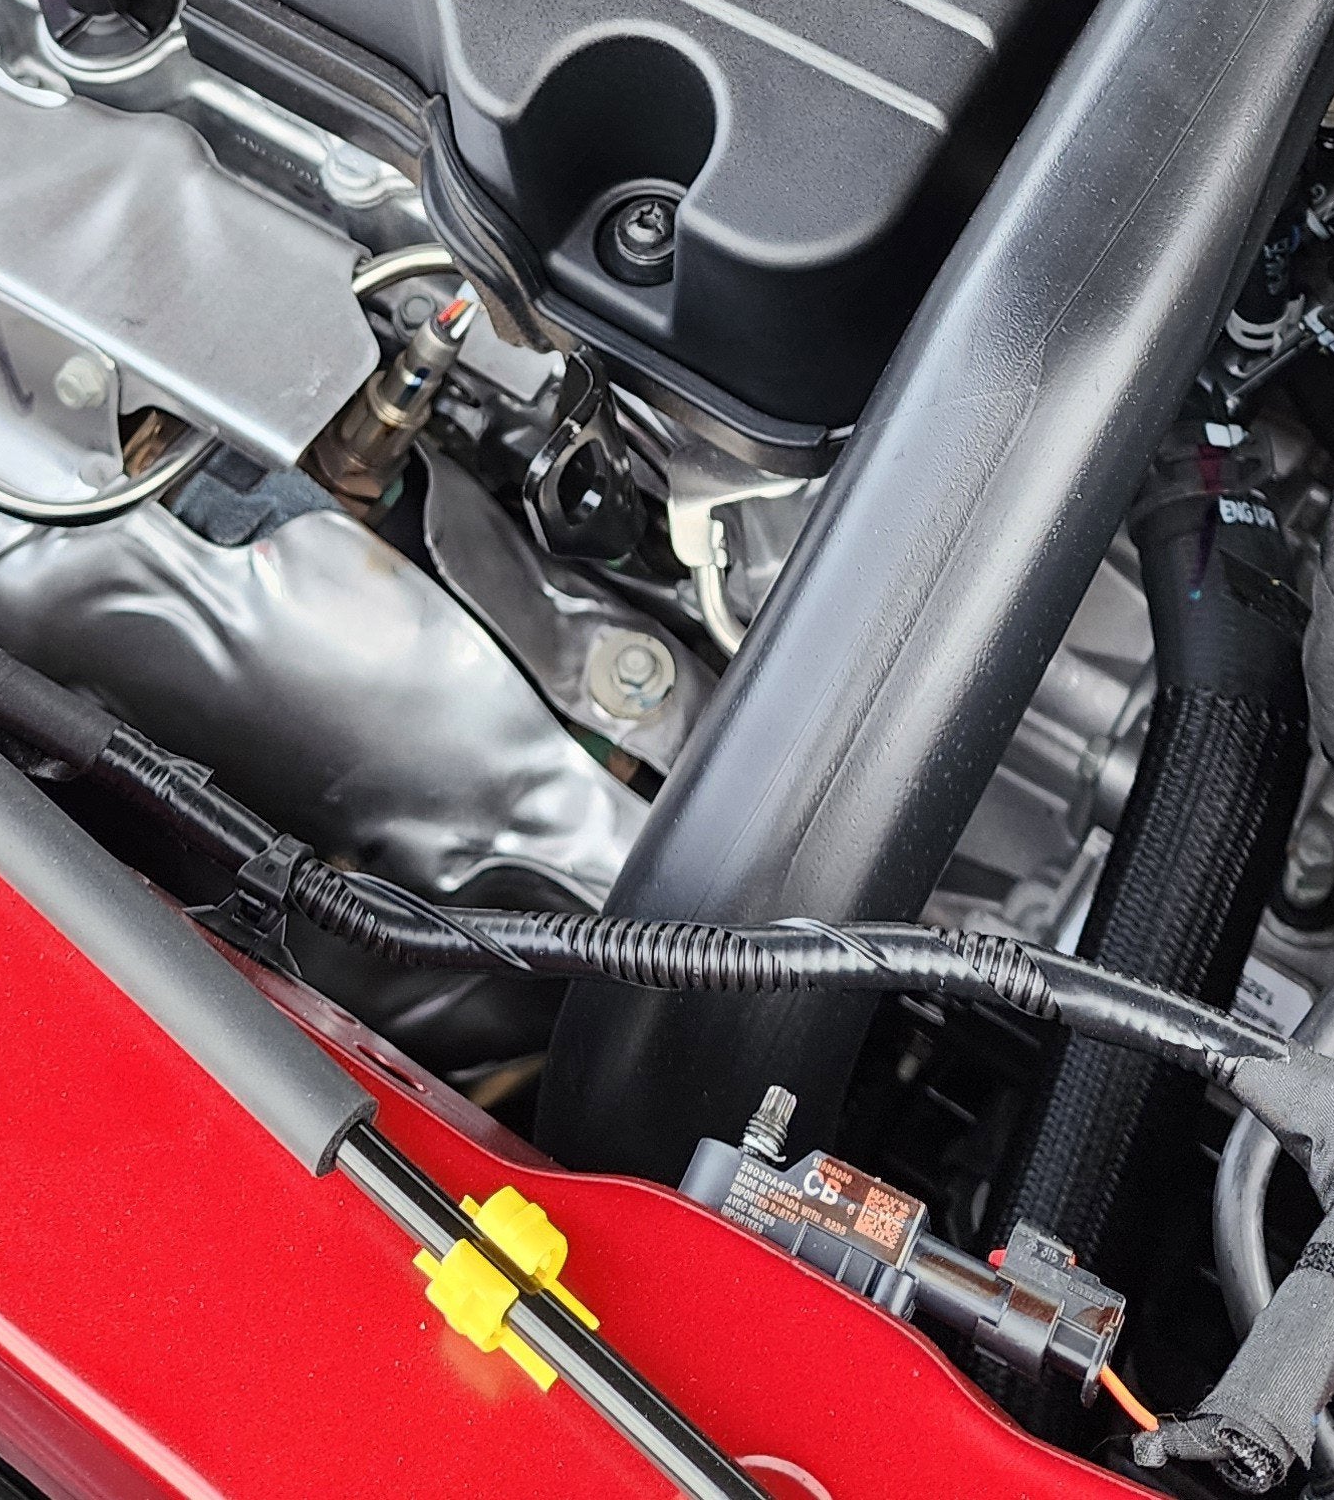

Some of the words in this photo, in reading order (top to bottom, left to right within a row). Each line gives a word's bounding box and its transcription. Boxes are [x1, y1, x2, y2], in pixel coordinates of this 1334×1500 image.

[1218, 496, 1254, 525] ENG
[730, 1182, 770, 1208] IMPORTED
[768, 1202, 801, 1225] PARTS/
[734, 1171, 759, 1194] MADE
[757, 1182, 769, 1197] IN
[767, 1188, 800, 1214] CANADA
[800, 1205, 823, 1224] WITH
[803, 1169, 842, 1205] CB
[720, 1204, 765, 1234] IMPORTEES
[725, 1194, 748, 1213] AVEC
[747, 1205, 777, 1227] PIECES
